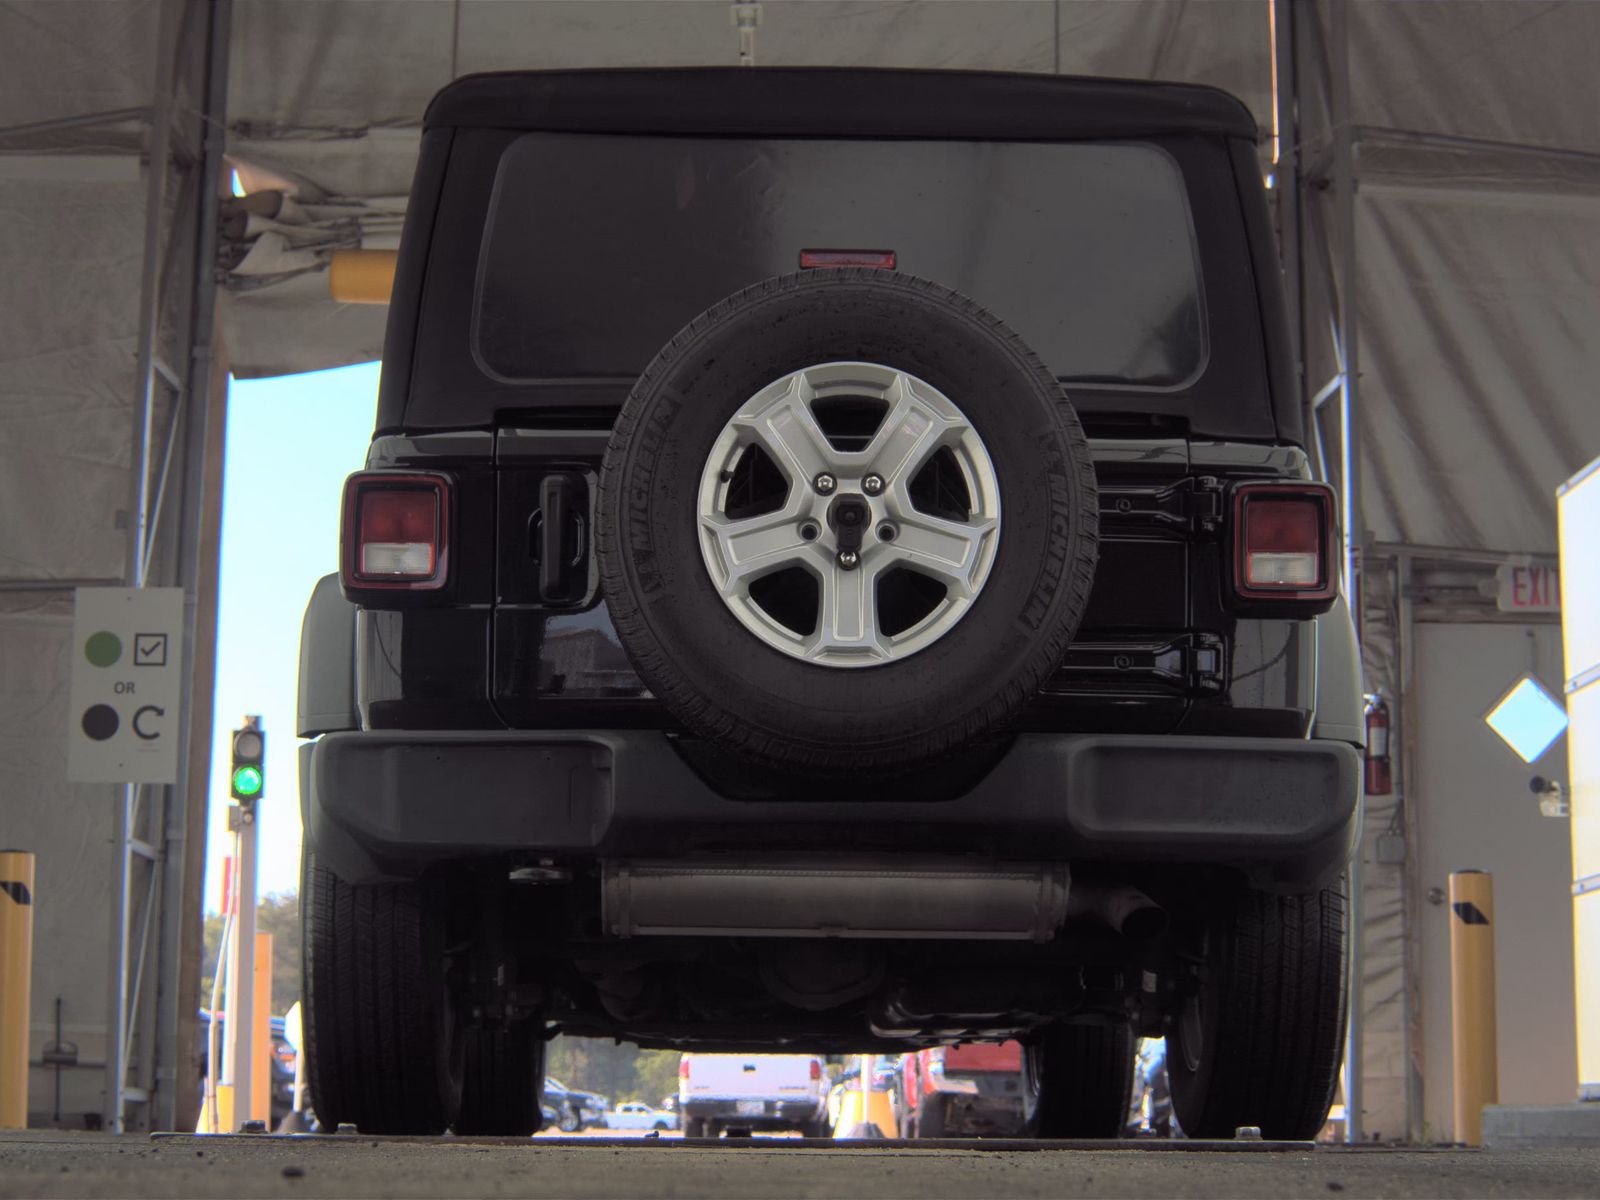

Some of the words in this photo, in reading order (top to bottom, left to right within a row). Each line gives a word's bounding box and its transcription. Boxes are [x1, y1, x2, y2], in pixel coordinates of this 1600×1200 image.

[629, 396, 675, 551] MICHELIN
[1024, 474, 1069, 630] MICHELIN
[114, 681, 136, 695] OR
